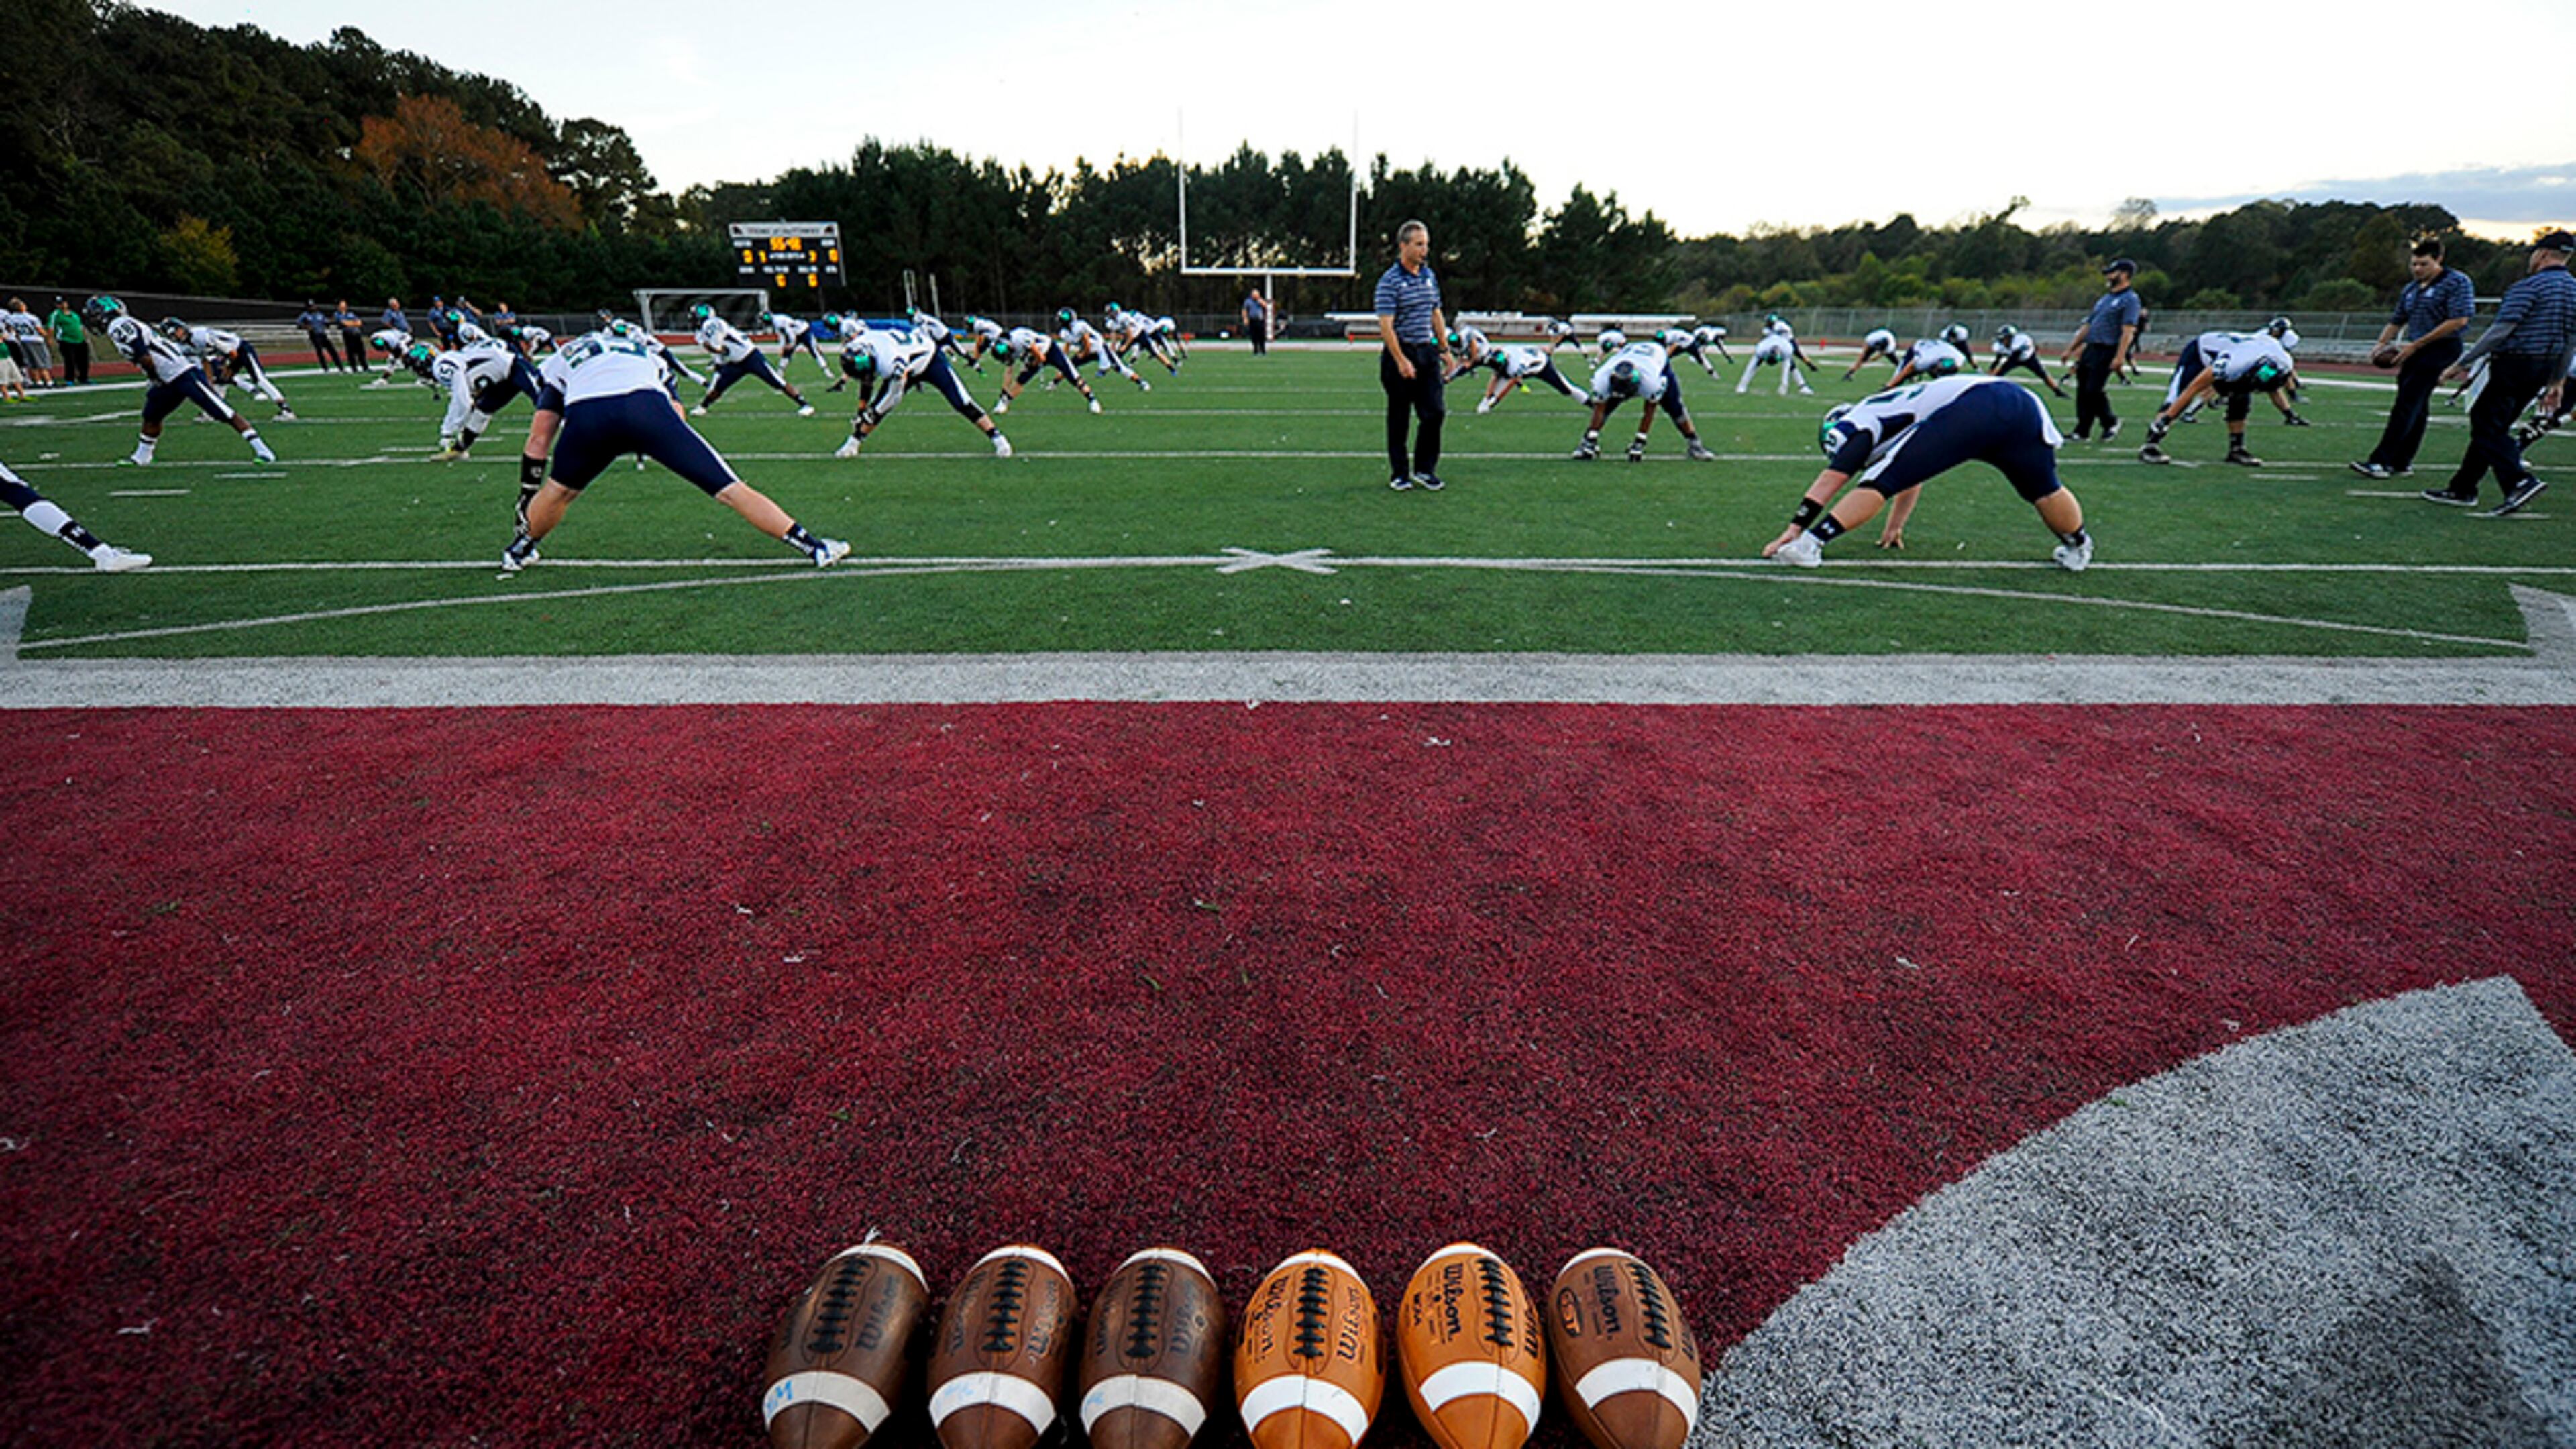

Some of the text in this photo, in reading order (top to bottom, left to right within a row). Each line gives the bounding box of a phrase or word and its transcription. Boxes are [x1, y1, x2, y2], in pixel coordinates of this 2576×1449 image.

[855, 1276, 894, 1351] Wilson
[1027, 1279, 1057, 1354] Wilson
[1337, 1286, 1360, 1359] Wilson
[1595, 1266, 1621, 1332] Wilson
